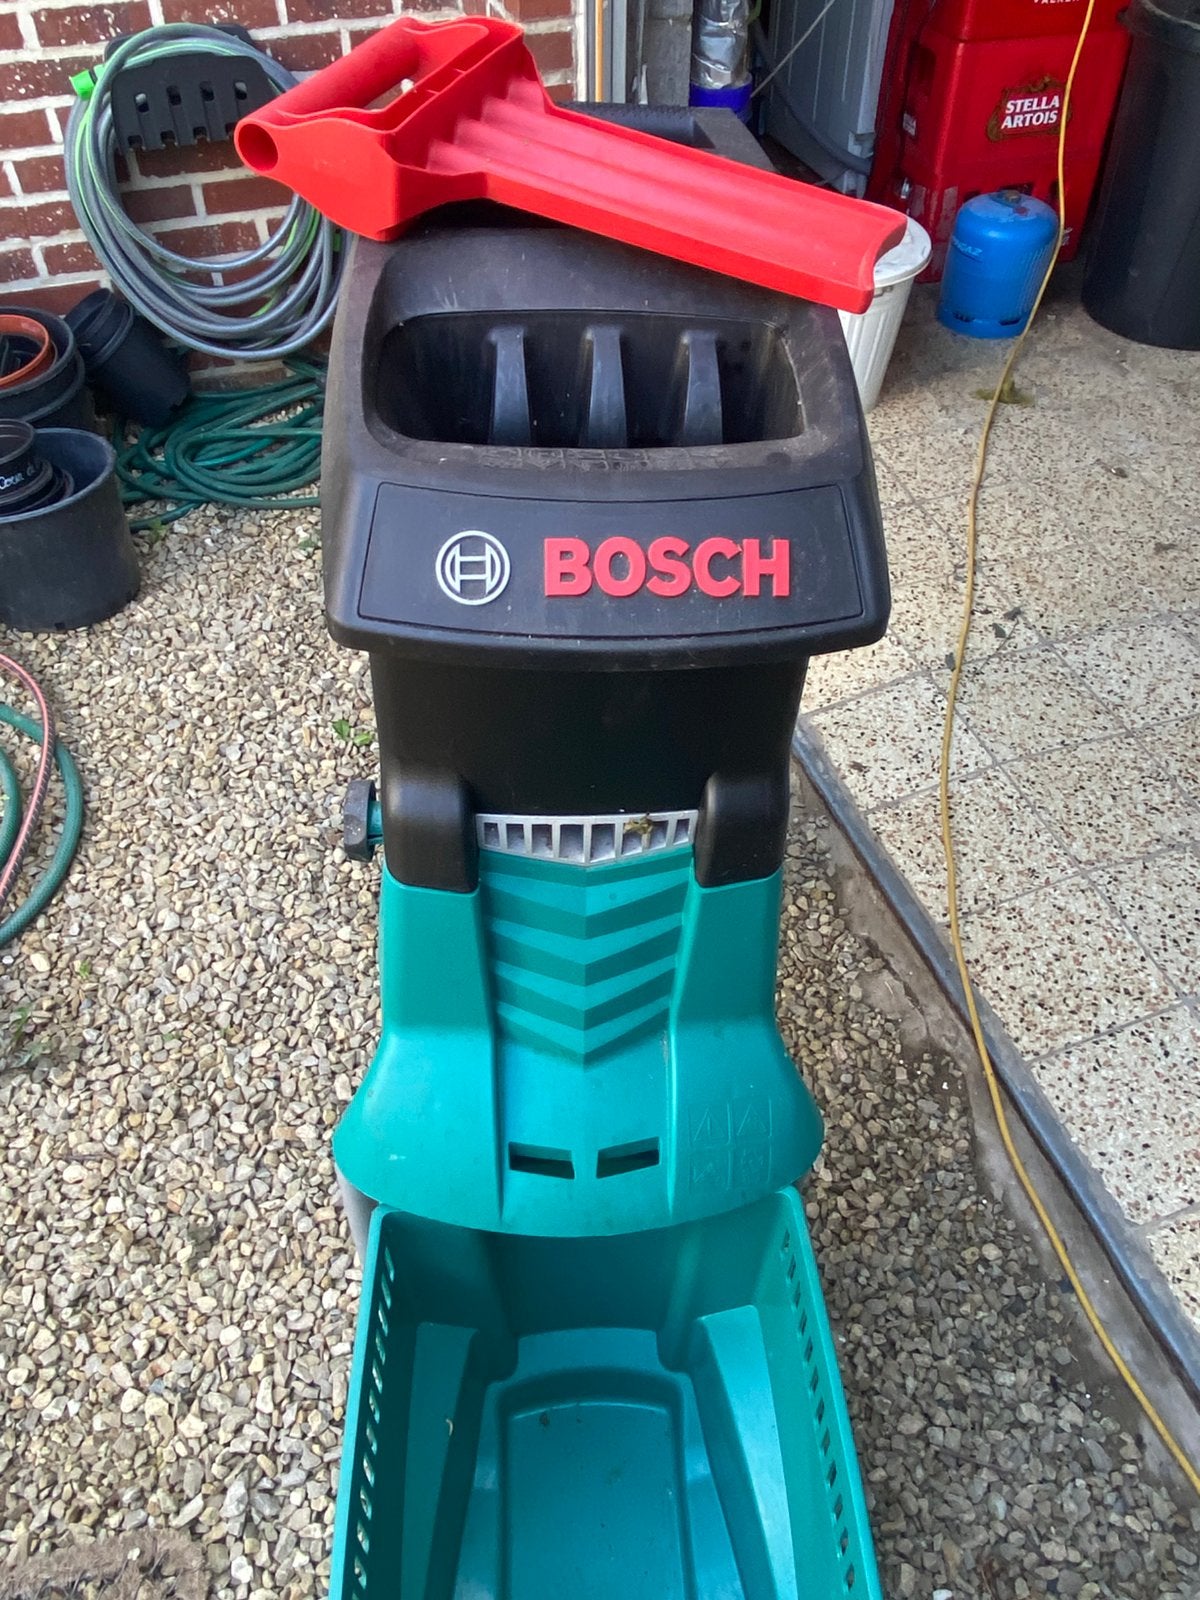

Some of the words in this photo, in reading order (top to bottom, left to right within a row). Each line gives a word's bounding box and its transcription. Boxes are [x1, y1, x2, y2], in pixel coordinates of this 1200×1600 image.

[1005, 95, 1060, 114] STELLA
[1001, 110, 1058, 129] ARTOIS
[544, 536, 791, 597] BOSCH
